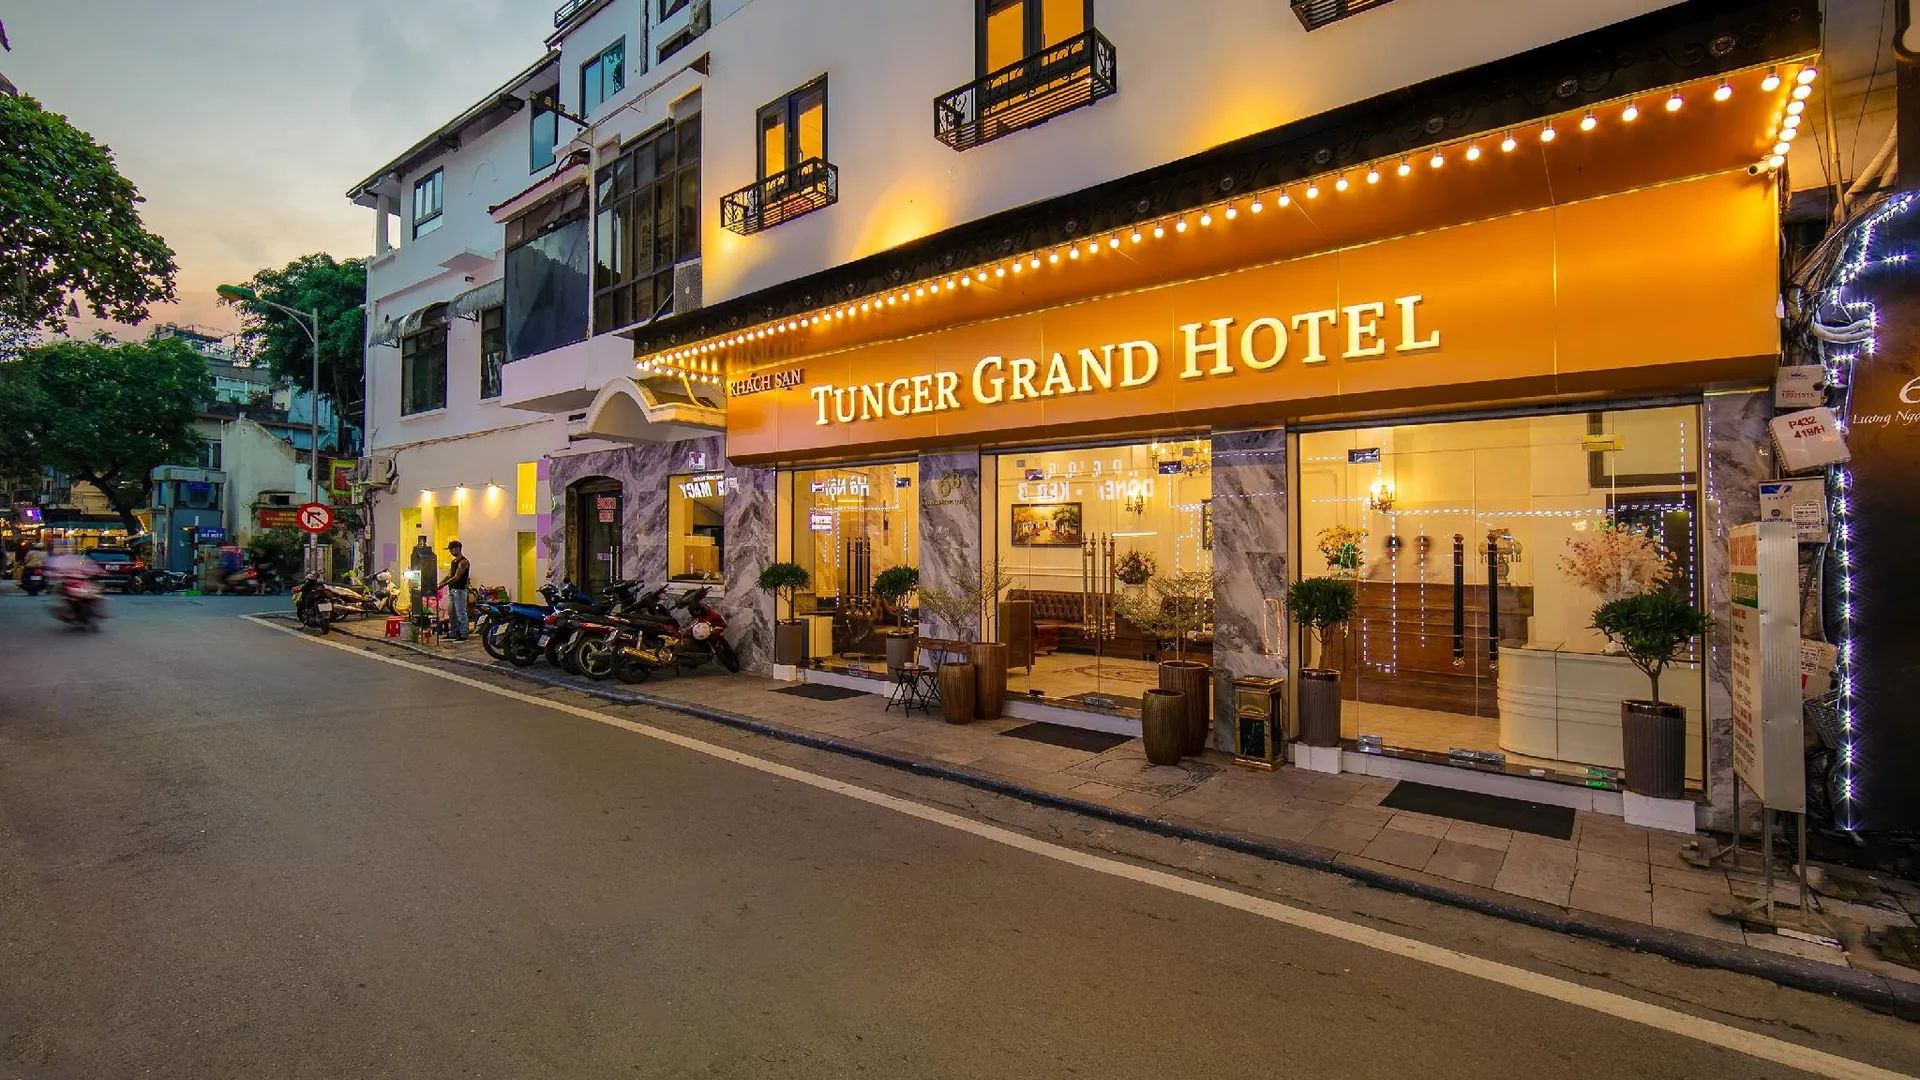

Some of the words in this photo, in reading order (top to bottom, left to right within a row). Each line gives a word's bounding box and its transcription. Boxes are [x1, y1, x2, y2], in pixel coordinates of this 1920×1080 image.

[811, 370, 961, 426] TUNGER
[972, 340, 1159, 405] GRAND
[1178, 294, 1441, 380] HOTEL
[730, 372, 772, 396] KHÁCH
[774, 367, 803, 390] SẠN
[1788, 416, 1817, 430] P432
